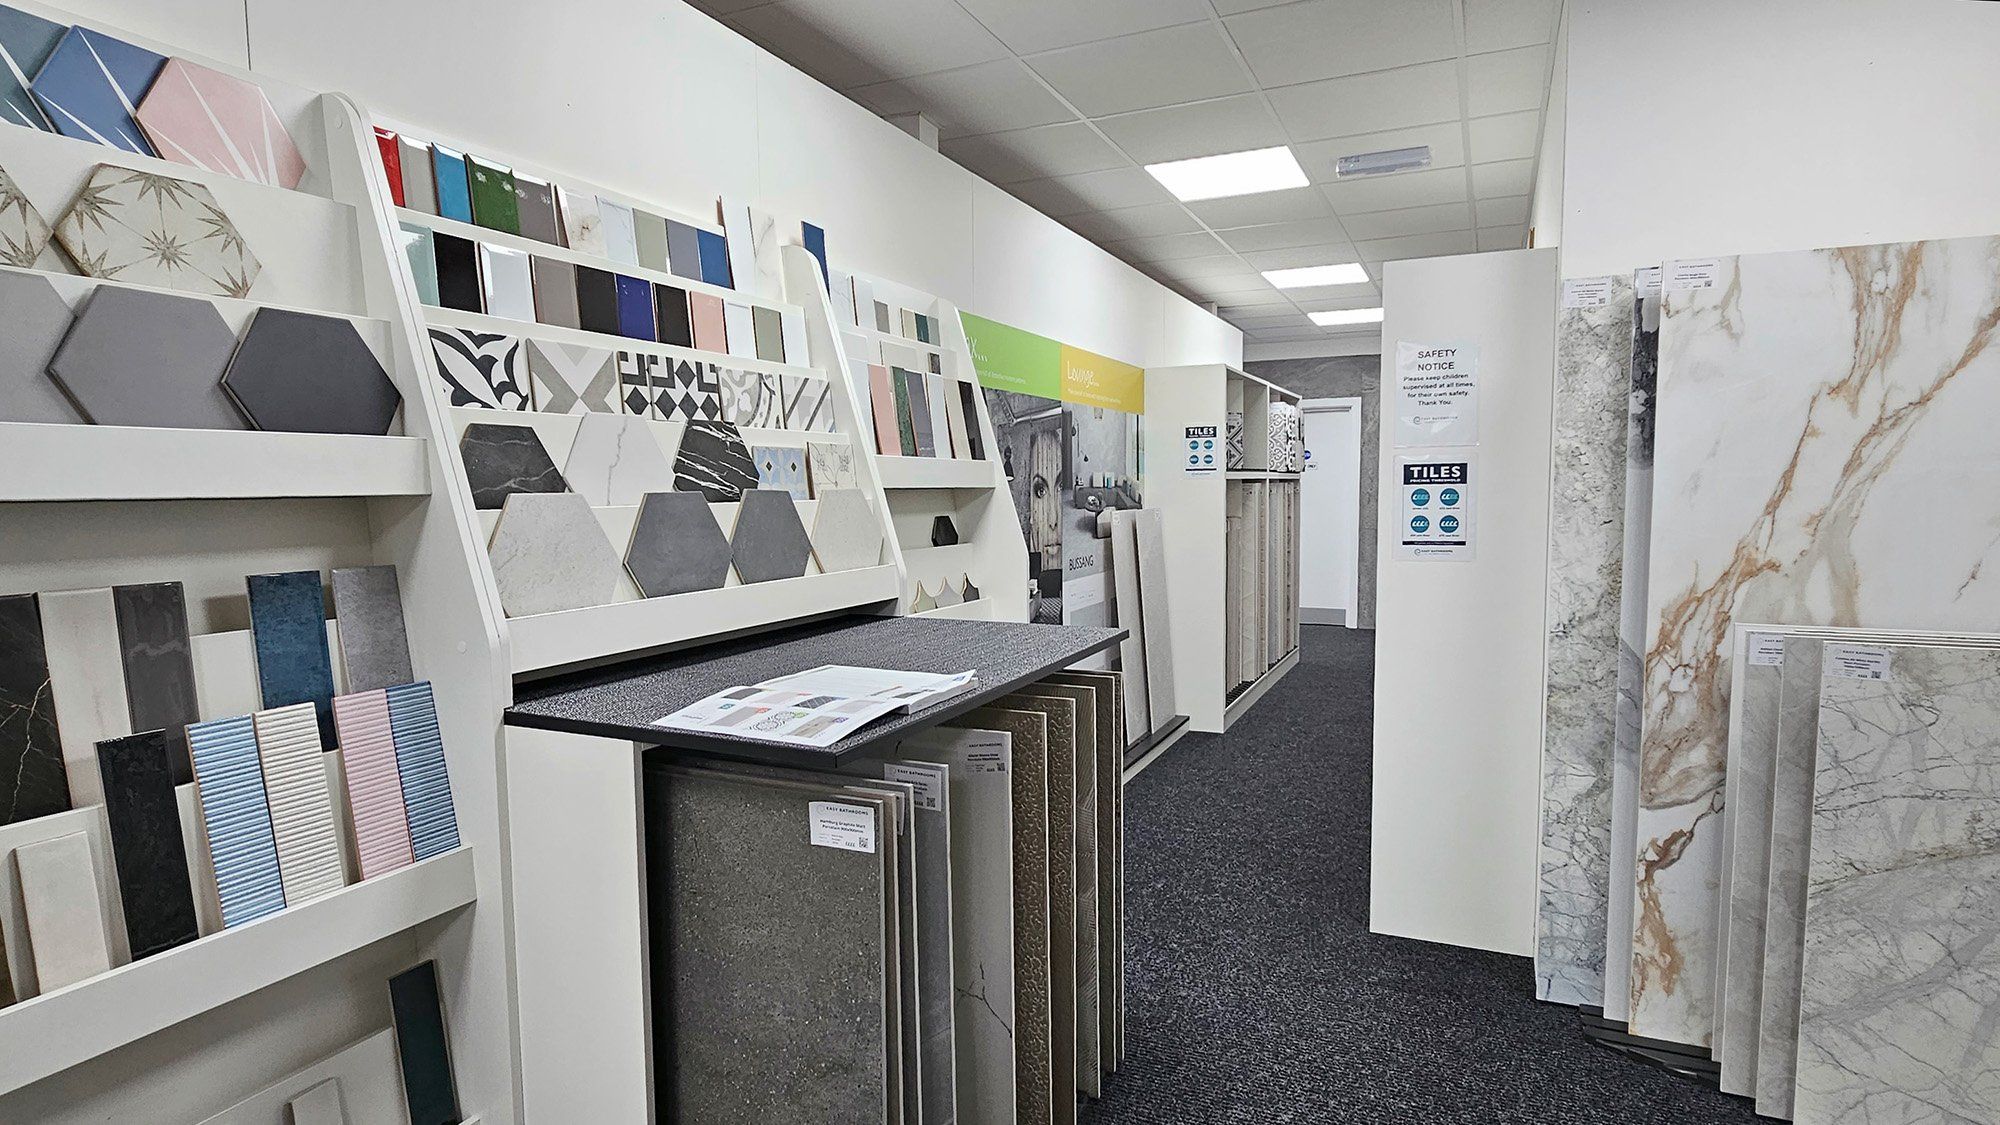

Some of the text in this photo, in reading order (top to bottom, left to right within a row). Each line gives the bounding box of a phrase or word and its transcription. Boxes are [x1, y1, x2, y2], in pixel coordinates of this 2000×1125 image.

[1418, 349, 1457, 359] SAFETY
[1417, 362, 1455, 371] NOTICE
[1188, 427, 1214, 435] TILES
[1409, 465, 1461, 478] TILES
[1069, 554, 1094, 571] BUSSANG
[839, 808, 869, 816] BATHROOMS
